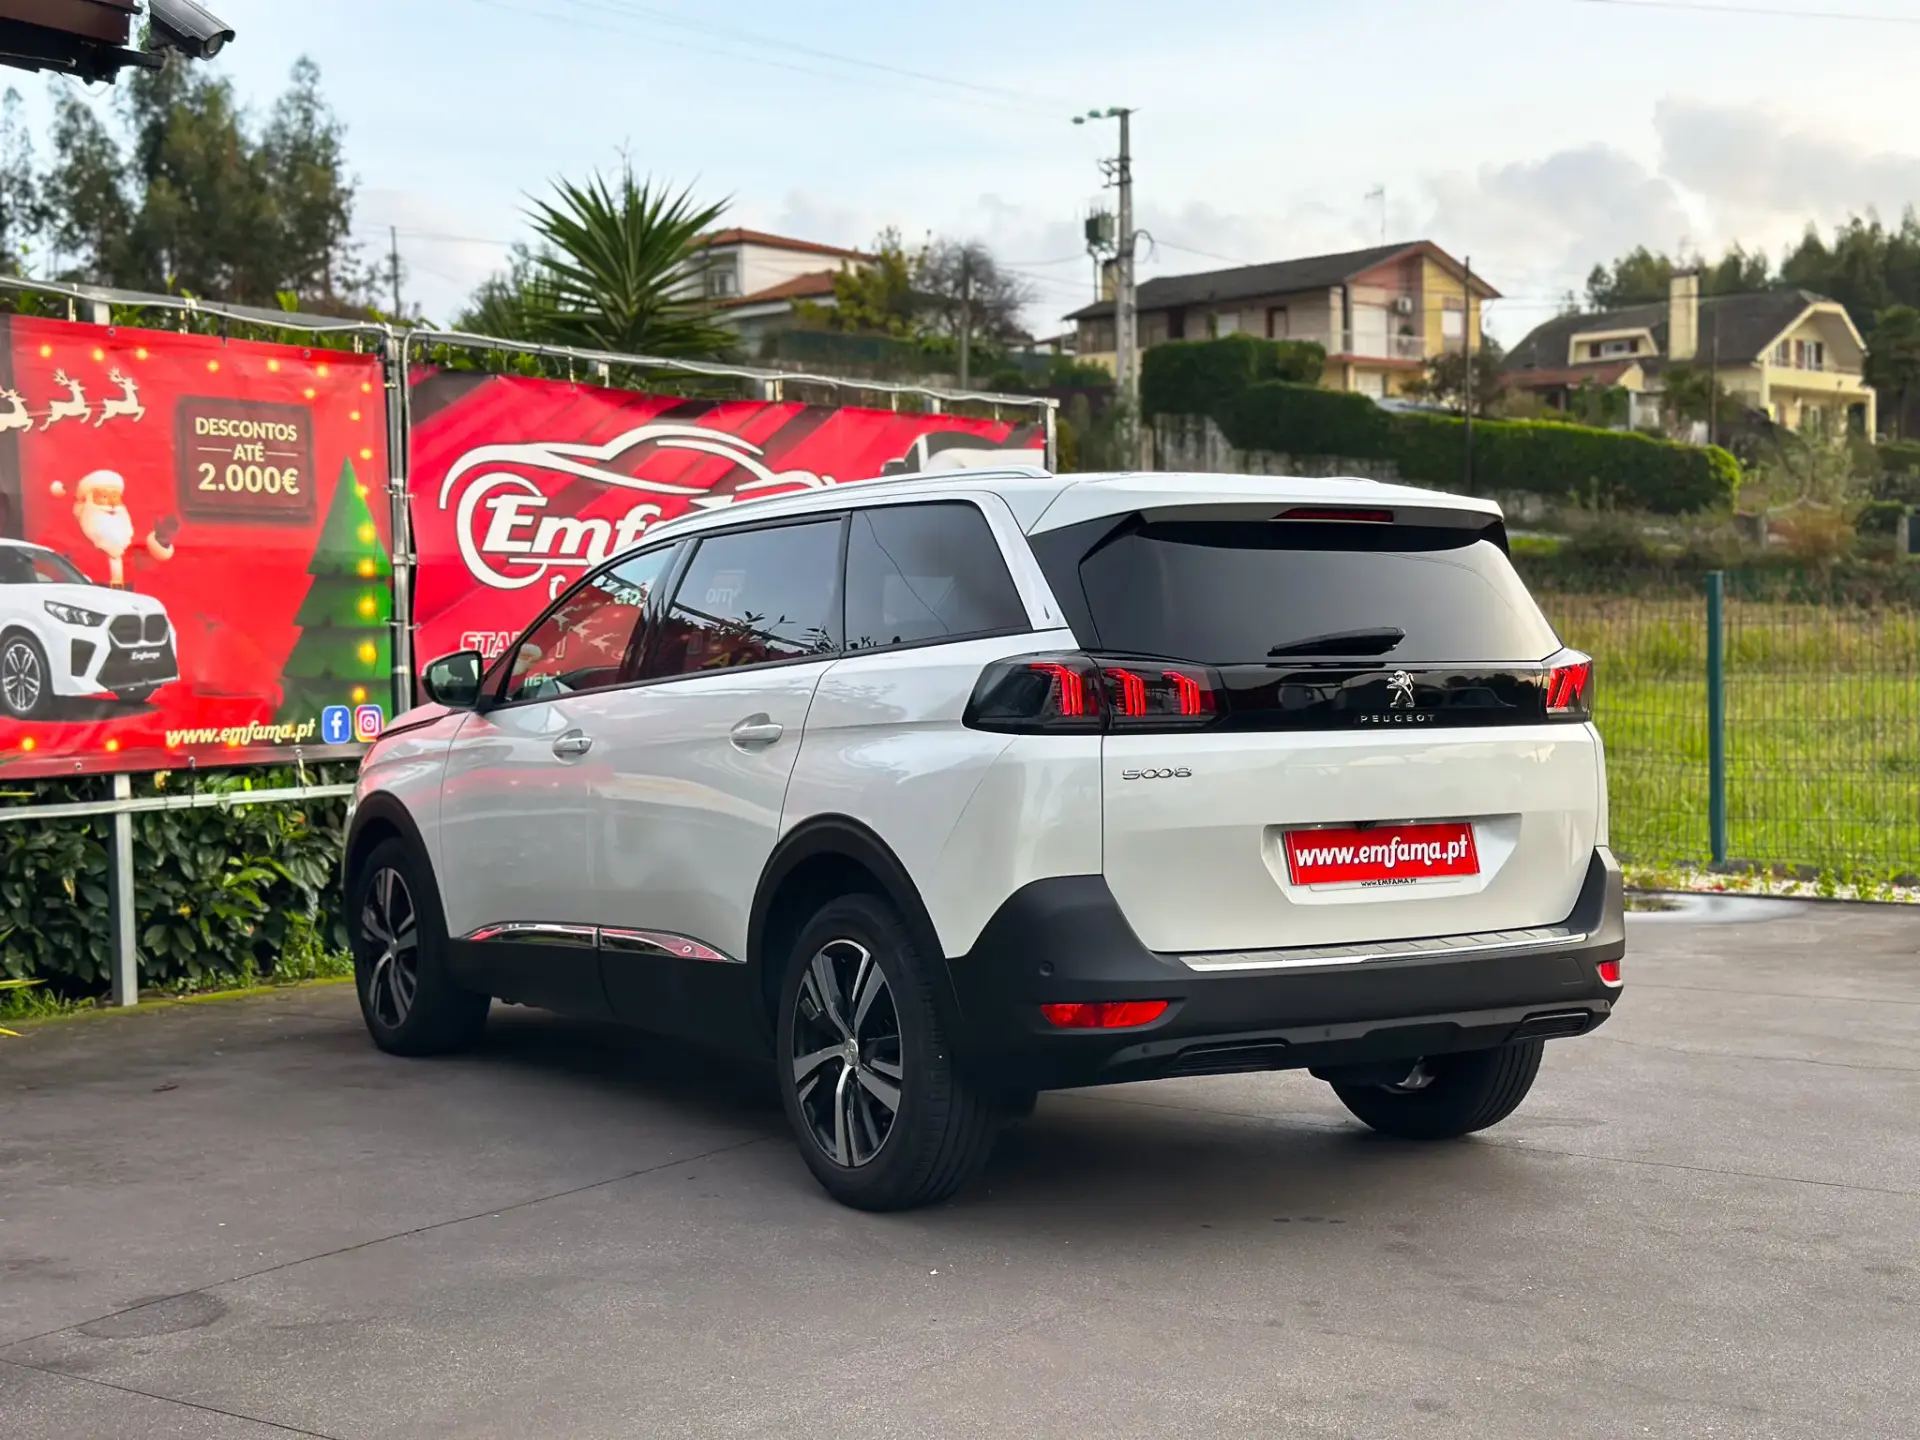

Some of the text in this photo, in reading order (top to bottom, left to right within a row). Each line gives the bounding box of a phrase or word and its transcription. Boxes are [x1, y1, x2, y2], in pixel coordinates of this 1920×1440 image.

[195, 416, 298, 442] DESCONTOS
[232, 441, 266, 462] ATÉ
[197, 462, 300, 495] 2.000€
[481, 494, 668, 566] Emf
[460, 631, 521, 658] STA
[165, 718, 316, 745] www.emfama.pt
[1360, 713, 1436, 723] PEUGEOT
[1121, 767, 1193, 781] 5008
[1296, 834, 1468, 869] www.emfama.pt
